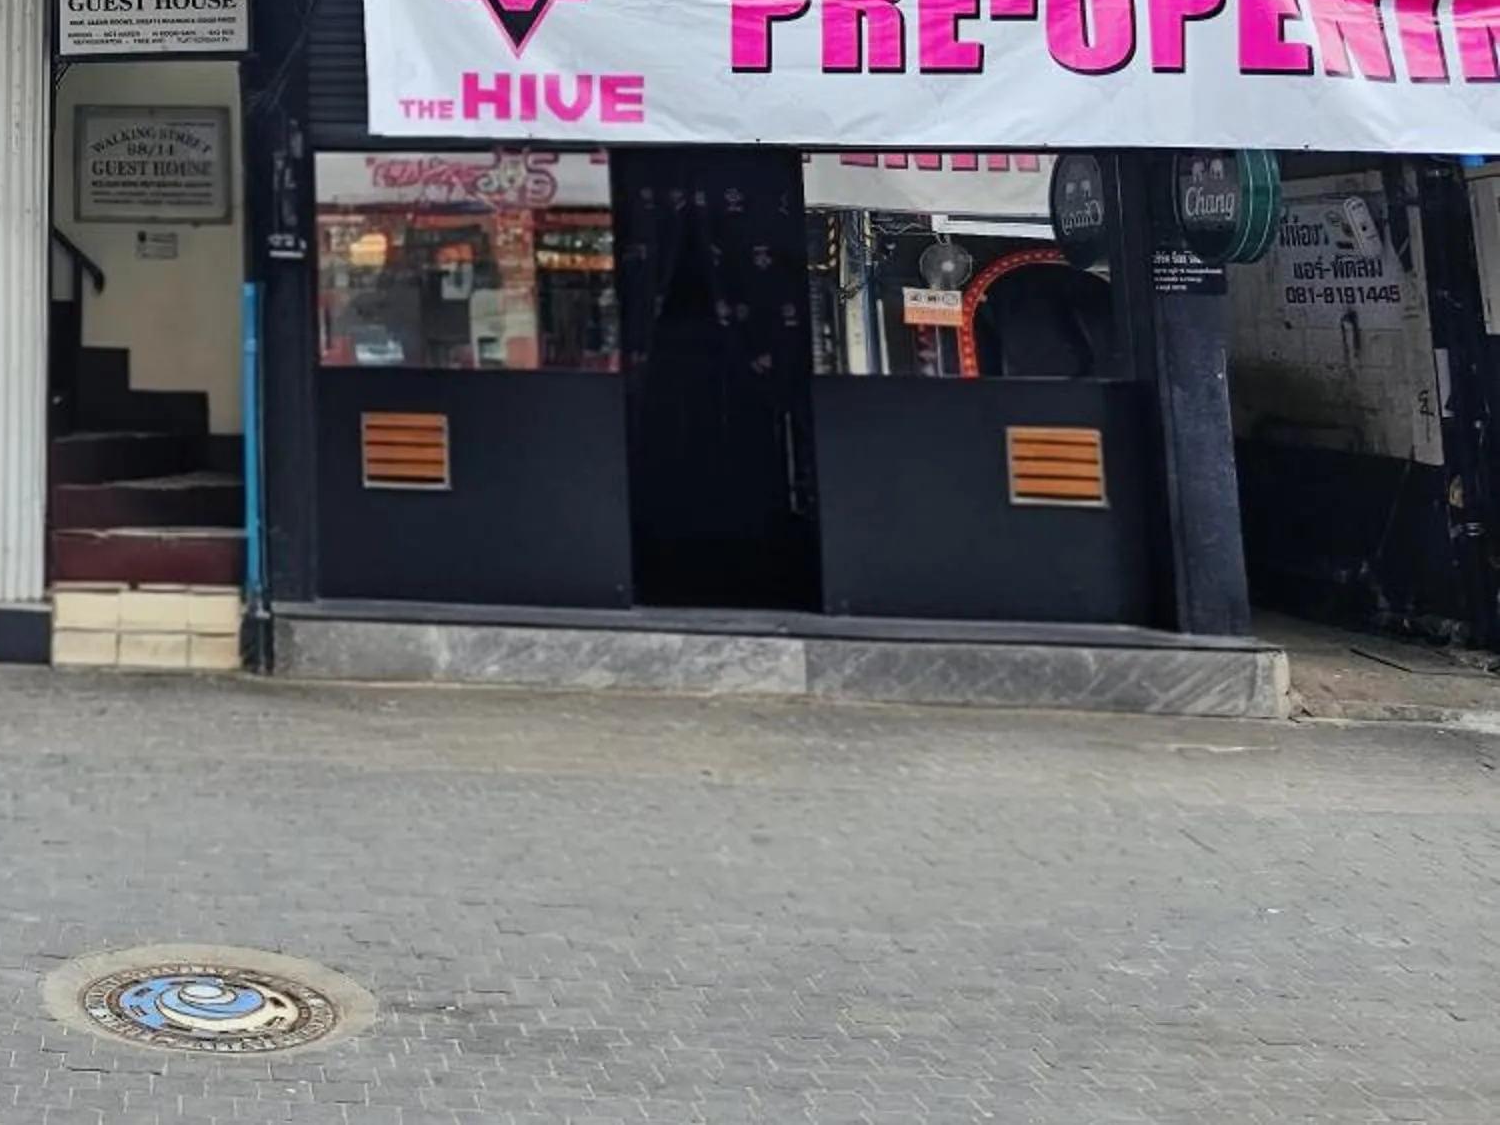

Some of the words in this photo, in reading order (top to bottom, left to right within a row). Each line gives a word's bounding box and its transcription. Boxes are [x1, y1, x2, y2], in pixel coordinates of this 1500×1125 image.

[399, 100, 454, 119] THE
[461, 72, 645, 123] HIVE
[91, 160, 149, 177] GUEST
[1185, 186, 1235, 219] Chang
